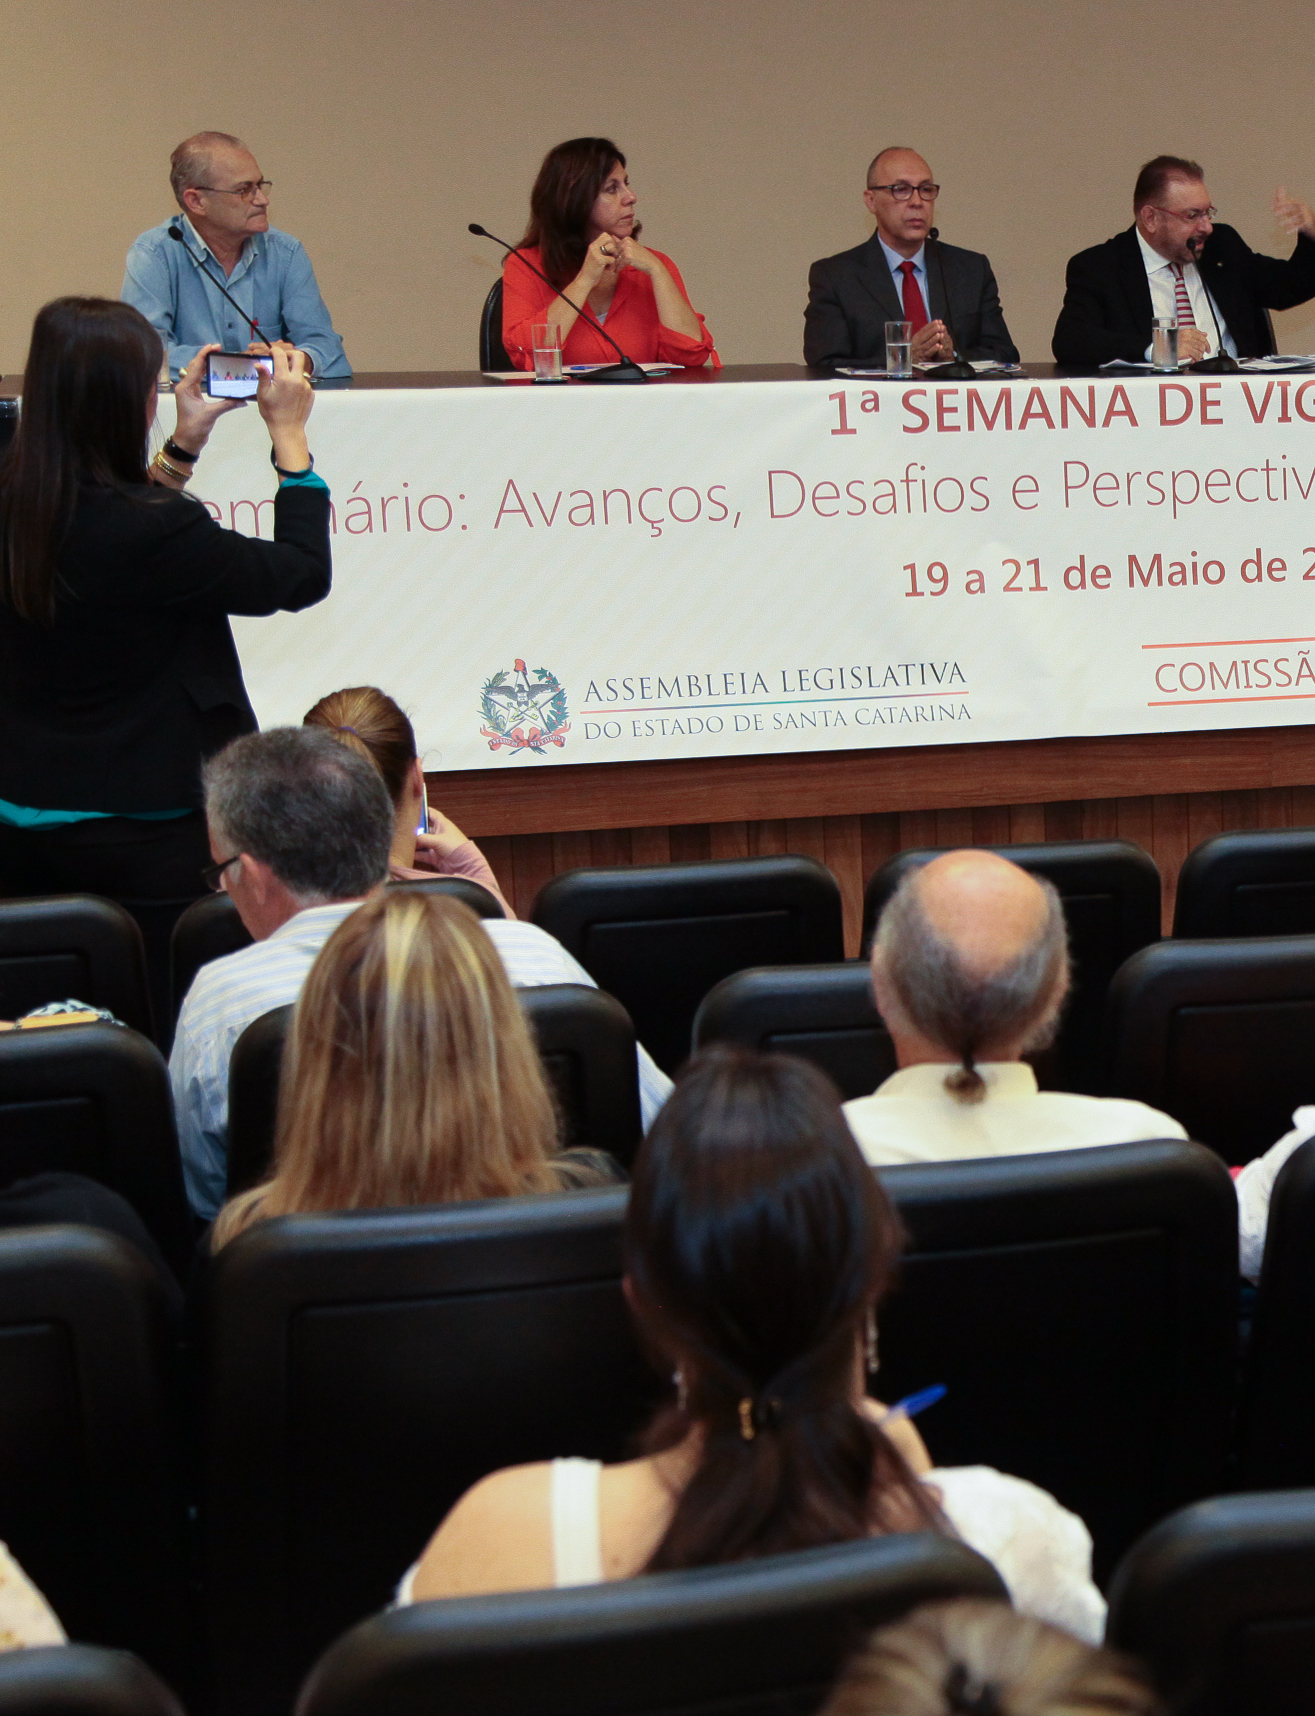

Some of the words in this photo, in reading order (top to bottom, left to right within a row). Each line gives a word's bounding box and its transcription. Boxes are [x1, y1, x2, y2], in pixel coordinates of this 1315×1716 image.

[901, 384, 1139, 434] SEMANA
[1158, 382, 1224, 427] DE
[493, 478, 742, 538] Avanços,
[767, 462, 990, 519] Desafios
[1011, 474, 1040, 511] e
[902, 561, 949, 598] 19
[965, 569, 986, 595] a
[1001, 557, 1049, 593] 21
[1063, 554, 1112, 591] de
[1127, 550, 1226, 588] Maio
[1240, 547, 1288, 584] de
[584, 671, 771, 703] ASSEMBLEIA
[781, 661, 968, 694] LEGISLATIVA
[584, 721, 622, 740] DO
[631, 716, 724, 738] ESTADO
[733, 714, 764, 732] DE
[773, 710, 848, 730] SANTA
[854, 703, 972, 726] CATARINA
